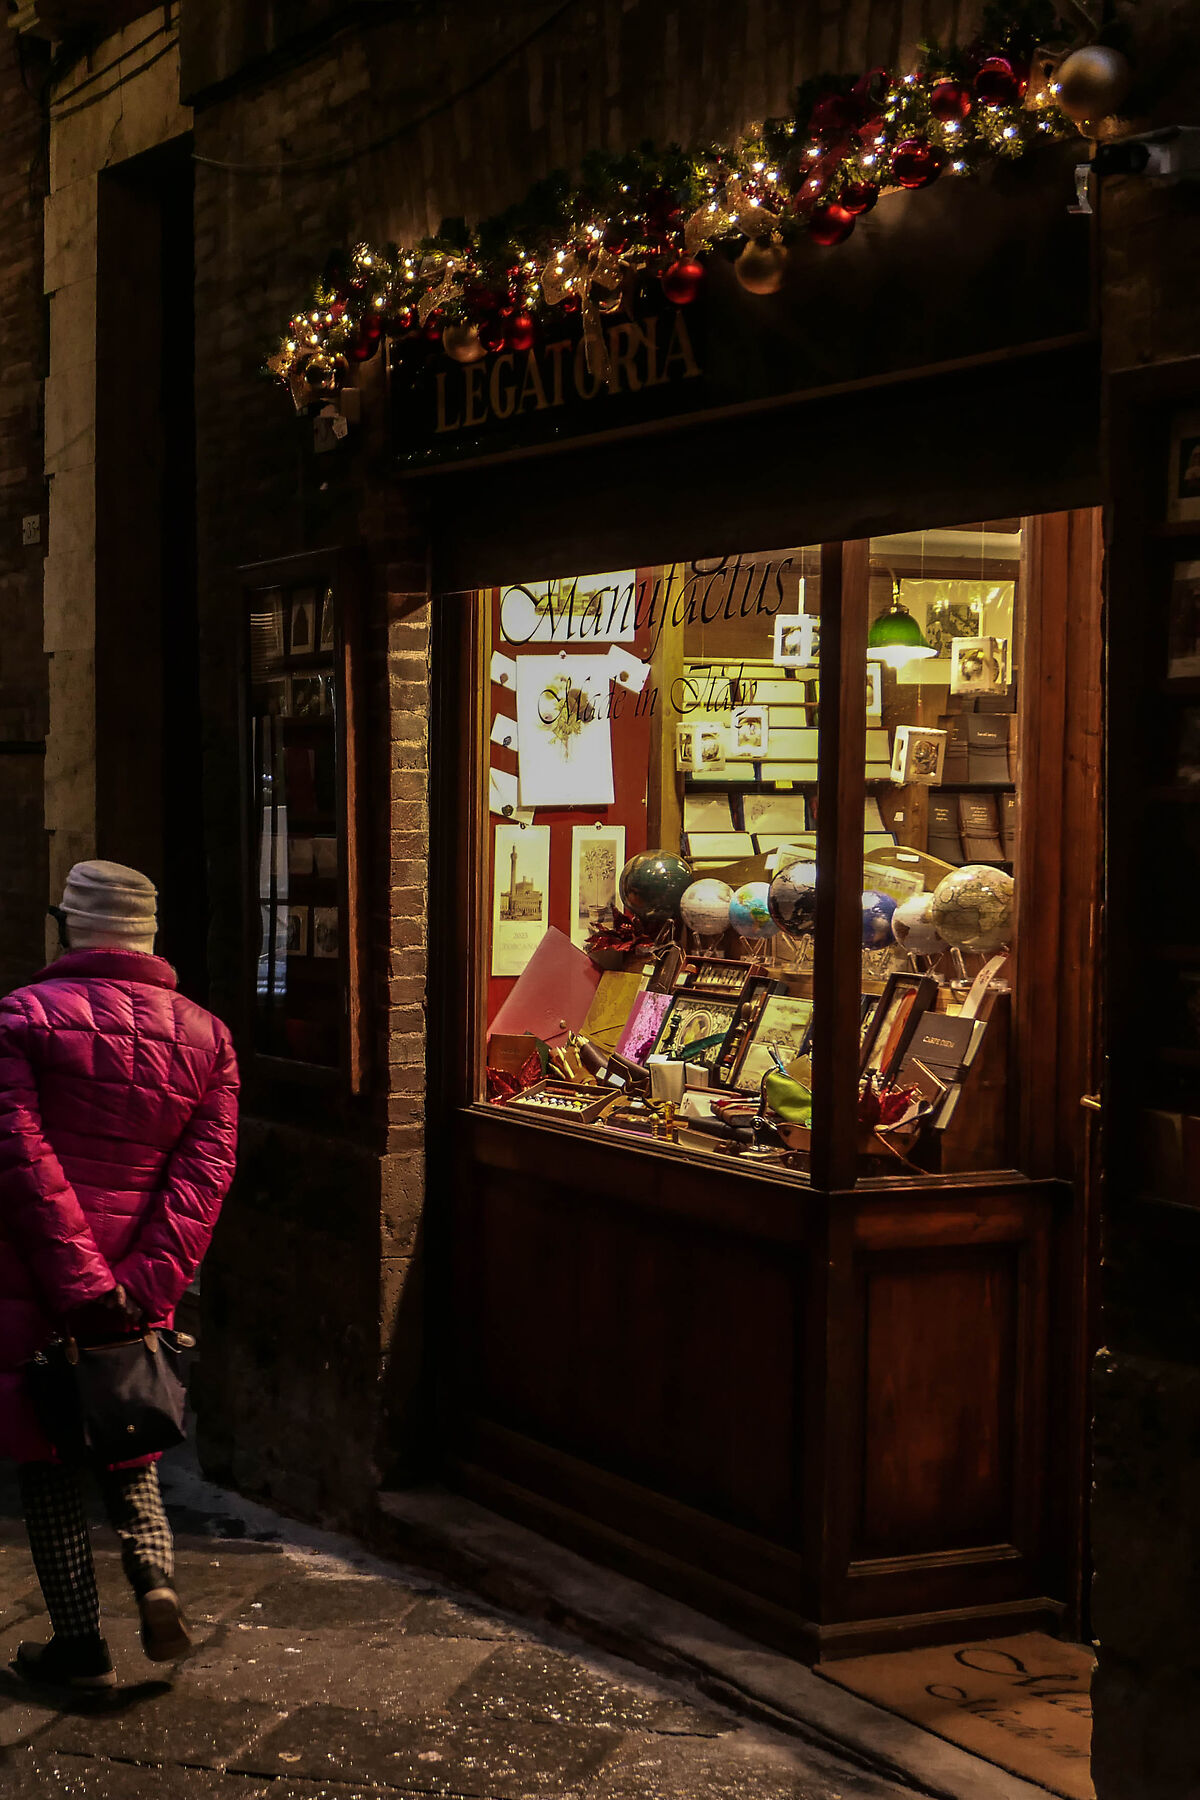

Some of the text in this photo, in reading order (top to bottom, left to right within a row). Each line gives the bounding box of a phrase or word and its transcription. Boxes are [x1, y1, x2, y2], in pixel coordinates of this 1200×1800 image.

[433, 309, 703, 434] LEGATORIA
[500, 555, 794, 664] Manufactus
[537, 662, 758, 729] Made in Italy
